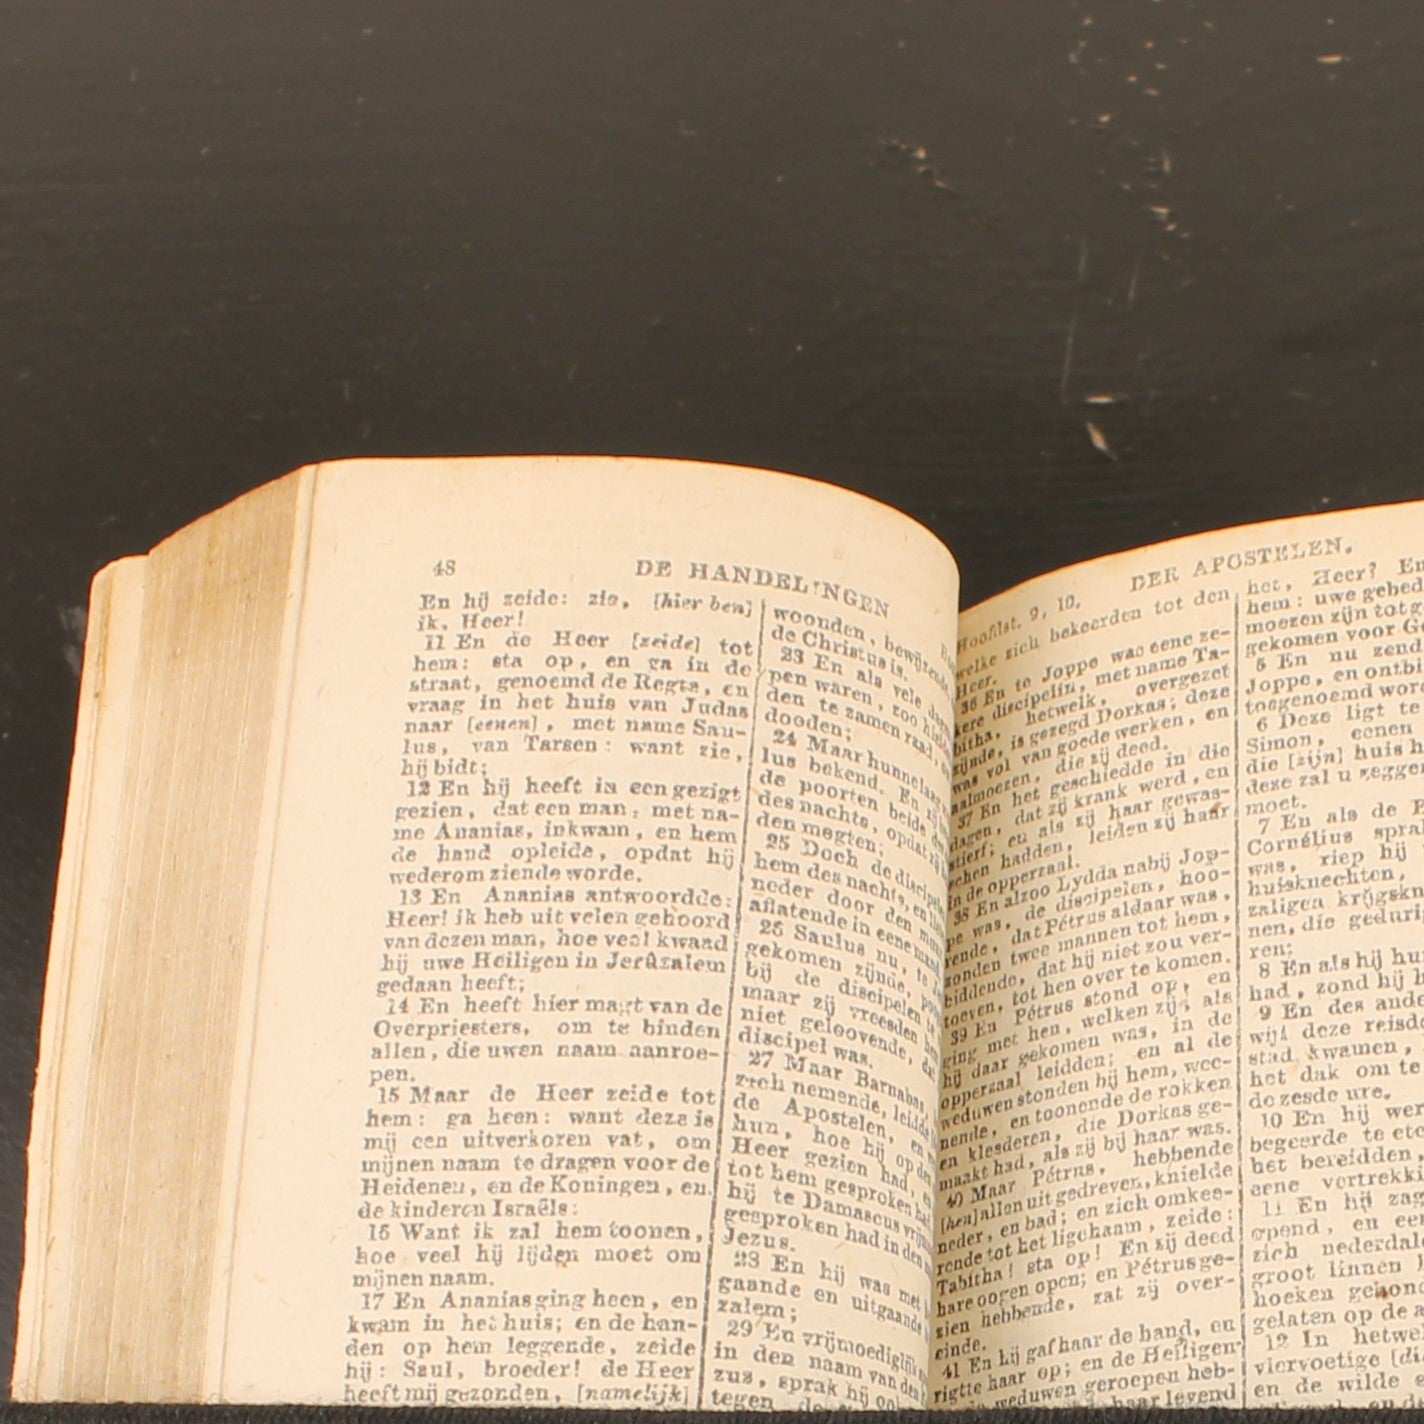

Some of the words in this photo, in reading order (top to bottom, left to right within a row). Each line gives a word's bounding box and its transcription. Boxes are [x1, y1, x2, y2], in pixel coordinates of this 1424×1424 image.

[433, 560, 456, 576] 48
[635, 560, 671, 577] DE
[419, 594, 450, 611] En
[463, 591, 489, 612] hij
[654, 592, 703, 611] [hier
[425, 634, 443, 651] 11
[454, 633, 485, 650] En
[505, 630, 531, 648] de
[553, 630, 609, 648] Heer
[719, 638, 753, 657] tot
[771, 624, 796, 643] de
[802, 628, 887, 668] Christus
[1245, 626, 1340, 660] gekomen
[1346, 624, 1395, 642] voor
[492, 654, 523, 668] sta
[605, 655, 630, 668] en
[648, 657, 673, 672] ga
[687, 655, 710, 673] in
[725, 659, 751, 677] de
[1256, 657, 1266, 672] 5
[1277, 652, 1308, 670] En
[1329, 649, 1358, 663] nu
[1373, 638, 1423, 658] zend
[813, 652, 843, 675] En
[856, 667, 882, 689] als
[893, 684, 921, 709] vele
[983, 689, 1005, 707] En
[1015, 677, 1031, 692] te
[1042, 657, 1098, 683] Joppe
[1150, 634, 1192, 654] eene
[773, 728, 797, 747] 24
[806, 734, 861, 761] Maar
[987, 758, 1010, 779] vol
[1022, 747, 1051, 765] van
[1057, 726, 1110, 757] goede
[1205, 706, 1229, 721] en
[761, 746, 796, 768] lus
[1259, 817, 1270, 835] 7
[1280, 813, 1311, 831] En
[1326, 806, 1358, 824] als
[1371, 802, 1397, 818] de
[950, 1027, 967, 1046] 39
[978, 1021, 997, 1039] En
[357, 1201, 384, 1219] de
[390, 1199, 485, 1218] kinderen
[819, 1260, 845, 1286] hij
[1027, 1257, 1054, 1275] sta
[1265, 1333, 1289, 1351] 12
[1302, 1329, 1329, 1348] In
[601, 1359, 628, 1377] de
[635, 1360, 694, 1379] Heer
